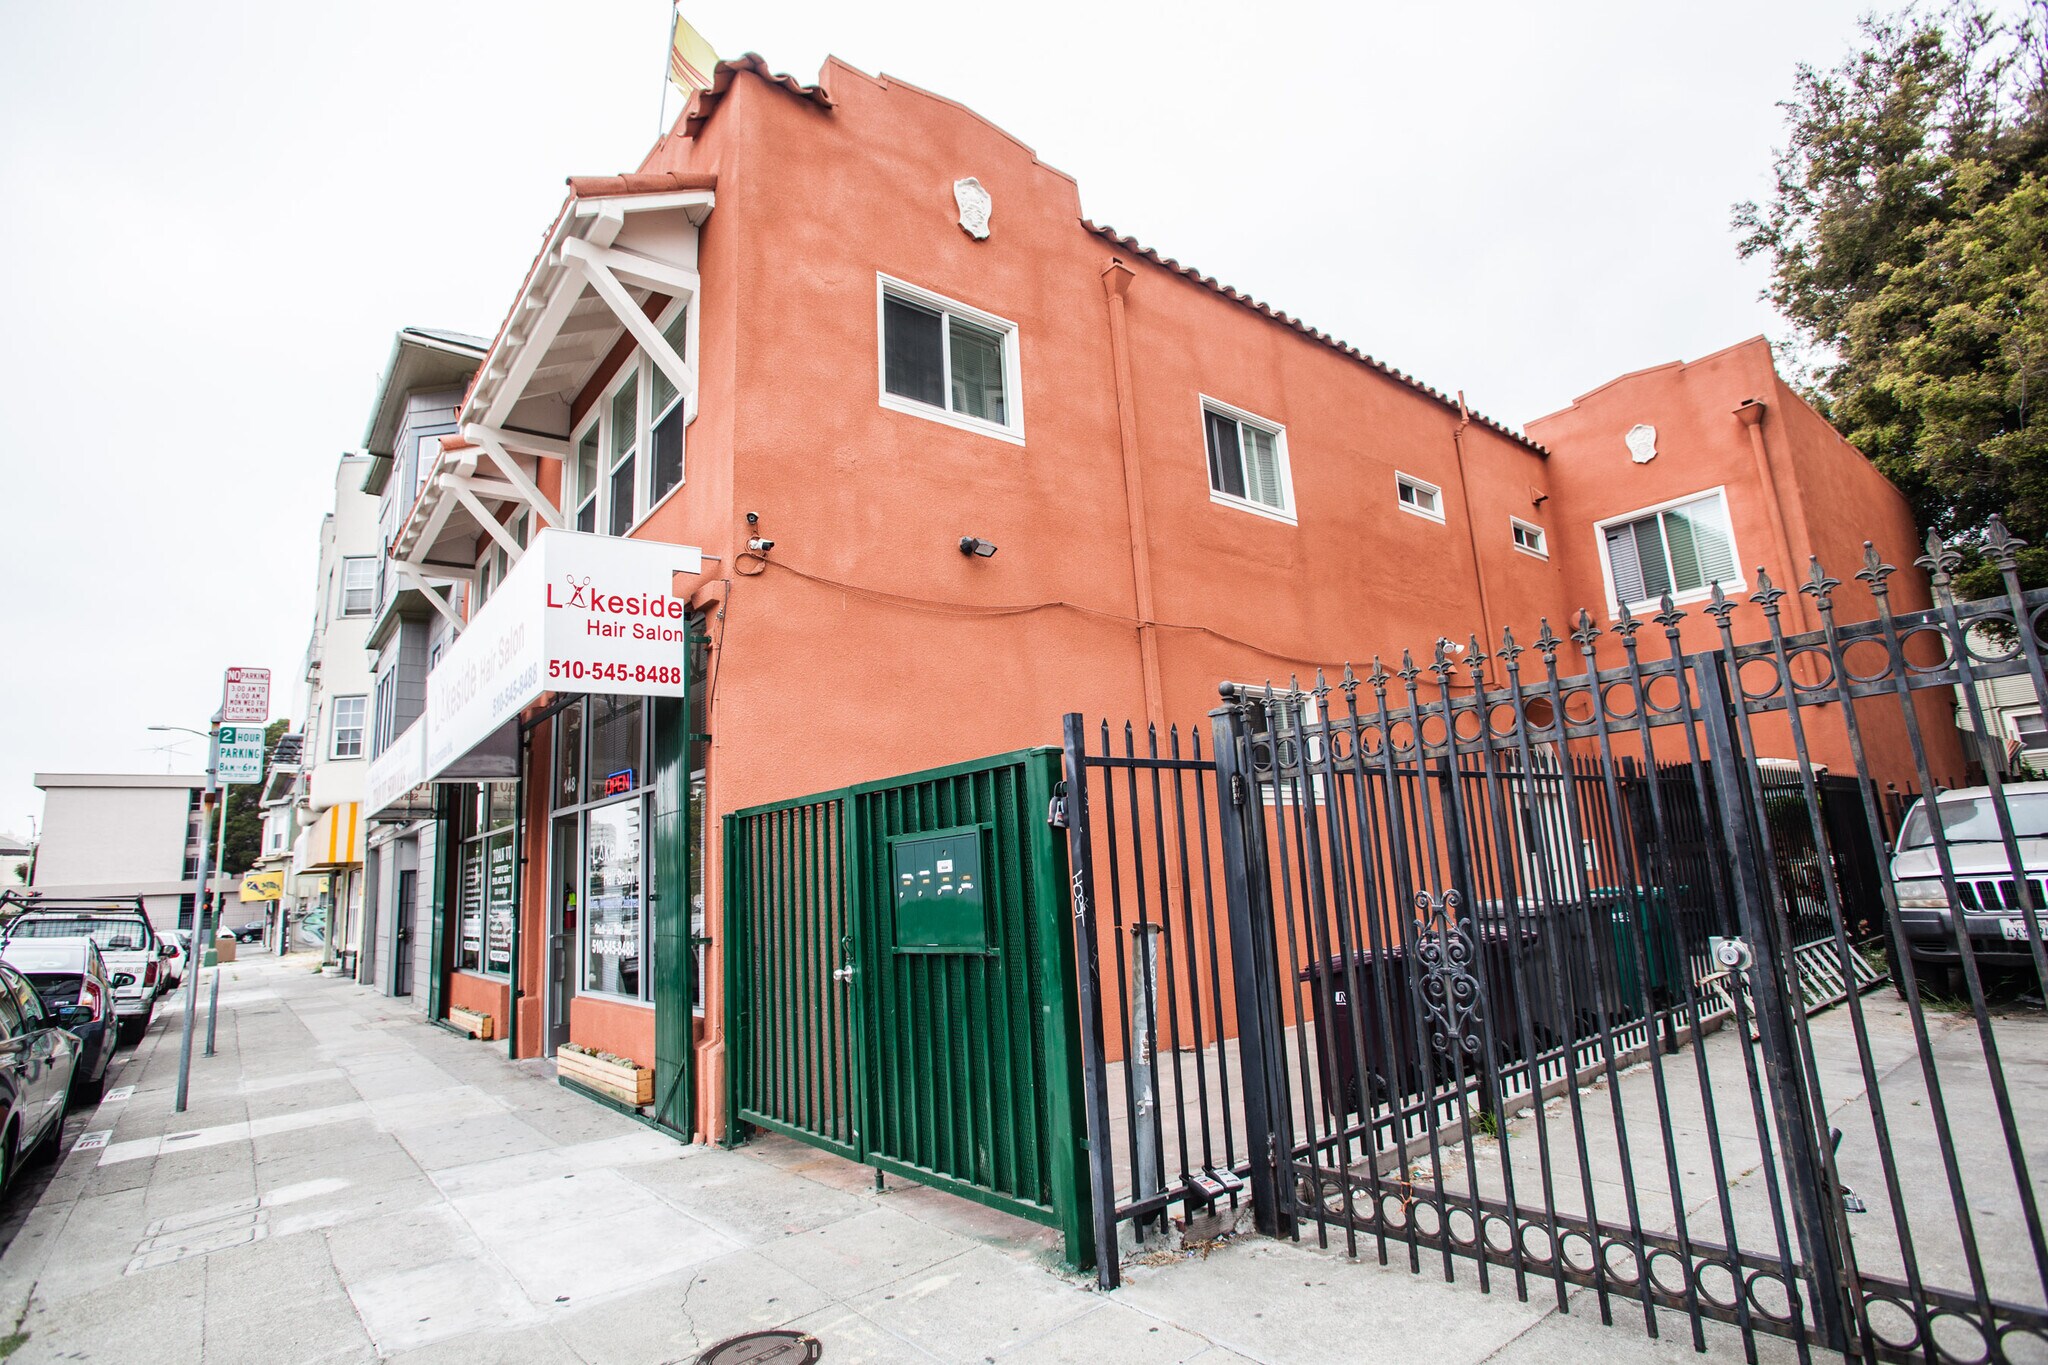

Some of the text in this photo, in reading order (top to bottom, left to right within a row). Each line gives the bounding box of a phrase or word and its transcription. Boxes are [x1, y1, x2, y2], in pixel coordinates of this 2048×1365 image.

[586, 619, 683, 643] Hair Salon
[499, 622, 525, 671] Salon
[228, 670, 269, 681] NO PARKING
[548, 660, 681, 685] 510-545-8488
[222, 729, 261, 742] 2 HOUR
[220, 747, 260, 759] PARKING
[563, 776, 576, 794] 148
[605, 774, 630, 795] OPEN
